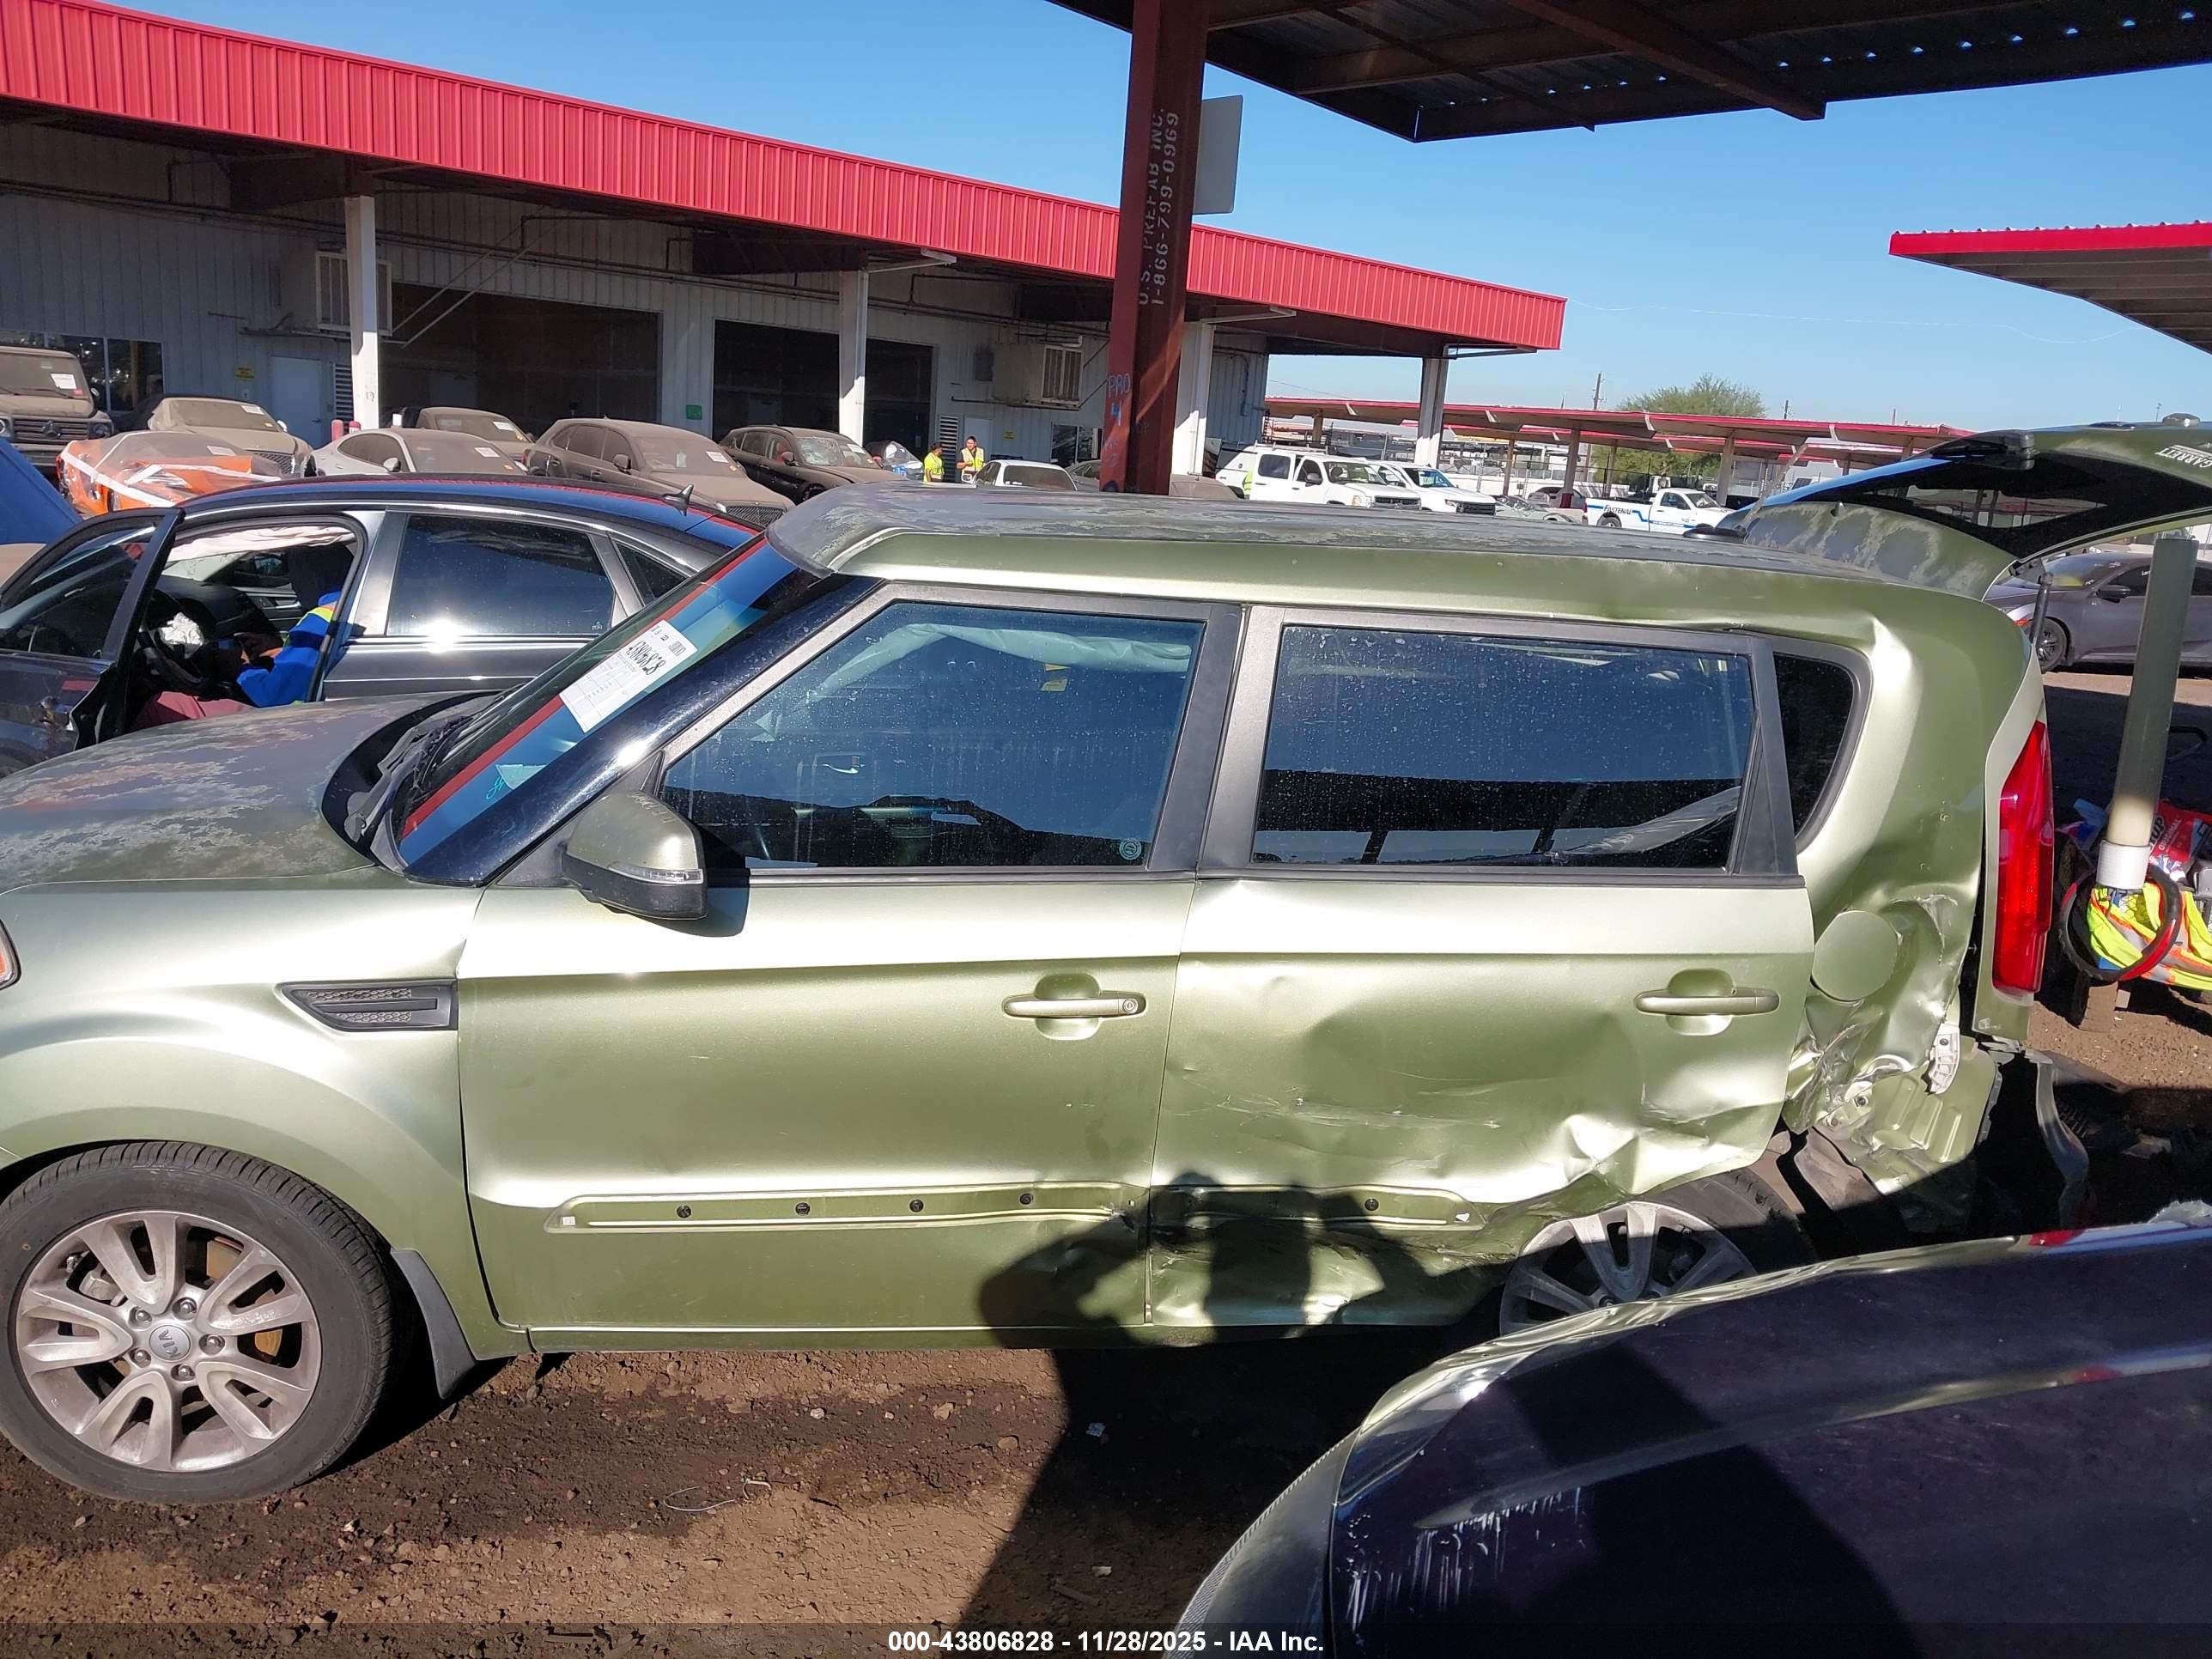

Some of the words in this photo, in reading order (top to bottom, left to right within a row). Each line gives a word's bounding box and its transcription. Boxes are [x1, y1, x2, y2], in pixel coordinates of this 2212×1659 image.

[1152, 108, 1164, 150] INC.
[1143, 161, 1160, 250] PREFAB
[1152, 112, 1179, 305] 1-866-799-0969
[1139, 264, 1152, 306] U.S.
[2154, 447, 2212, 468] GARRETT
[1603, 504, 1632, 515] FASTENAL
[2158, 818, 2182, 851] ORIGINAL
[158, 1328, 182, 1358] KIA
